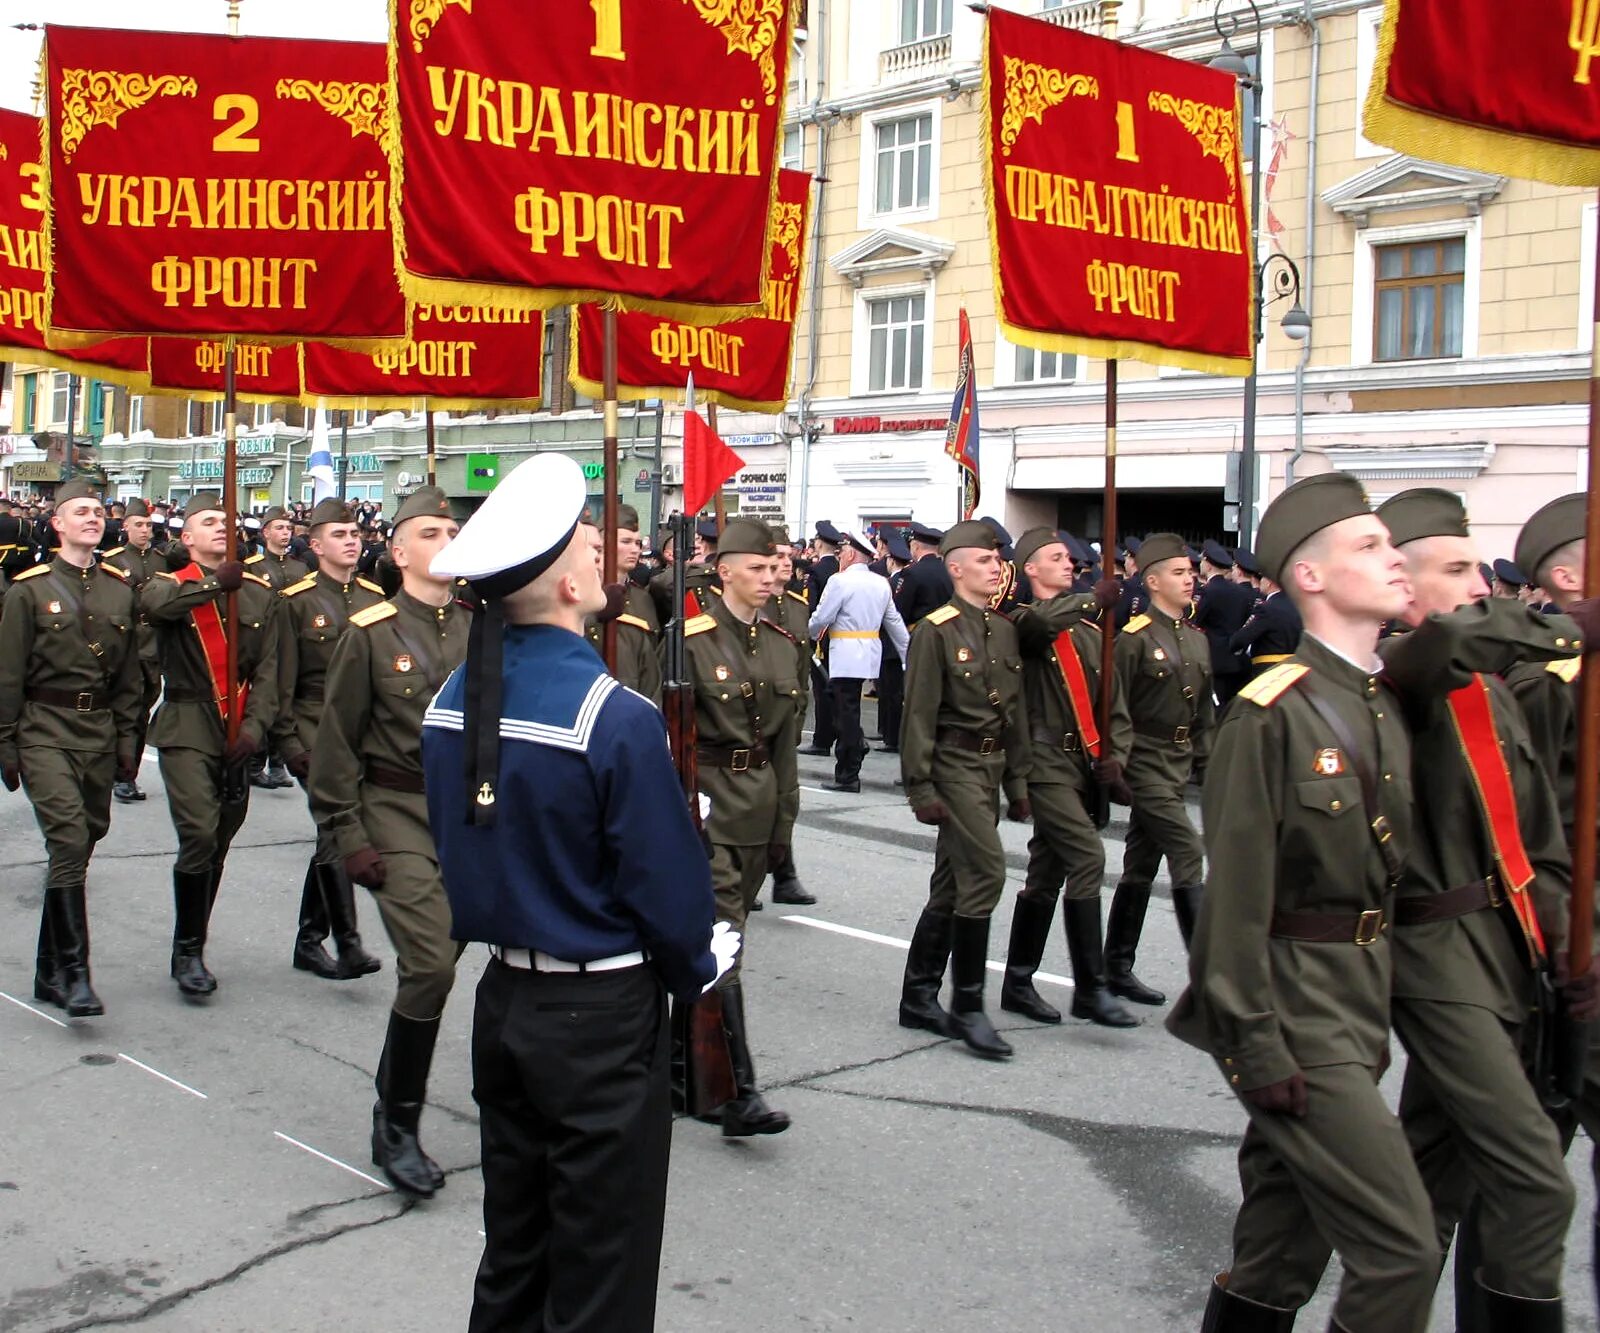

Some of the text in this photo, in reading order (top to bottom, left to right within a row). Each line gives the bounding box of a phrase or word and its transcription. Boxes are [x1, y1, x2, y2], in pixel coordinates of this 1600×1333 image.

[590, 0, 626, 60] 1
[212, 93, 261, 153] 2
[426, 66, 761, 176] УКРАИНСКИЙ
[1115, 101, 1140, 163] 1
[19, 162, 46, 211] 3
[77, 170, 386, 231] УКРАИНСКИЙ
[1005, 165, 1243, 254] ПРИБАЛТИЙСКИЙ
[514, 186, 685, 269] ФРОНТ
[151, 255, 318, 309] ФРОНТ
[1086, 259, 1181, 322] ФРОНТ
[373, 339, 477, 376] ФРОНТ
[651, 322, 744, 376] ФРОНТ
[177, 460, 225, 479] ЗЕЛЕНЫ
[729, 435, 773, 444] ПРОФИ ЦЕНТР
